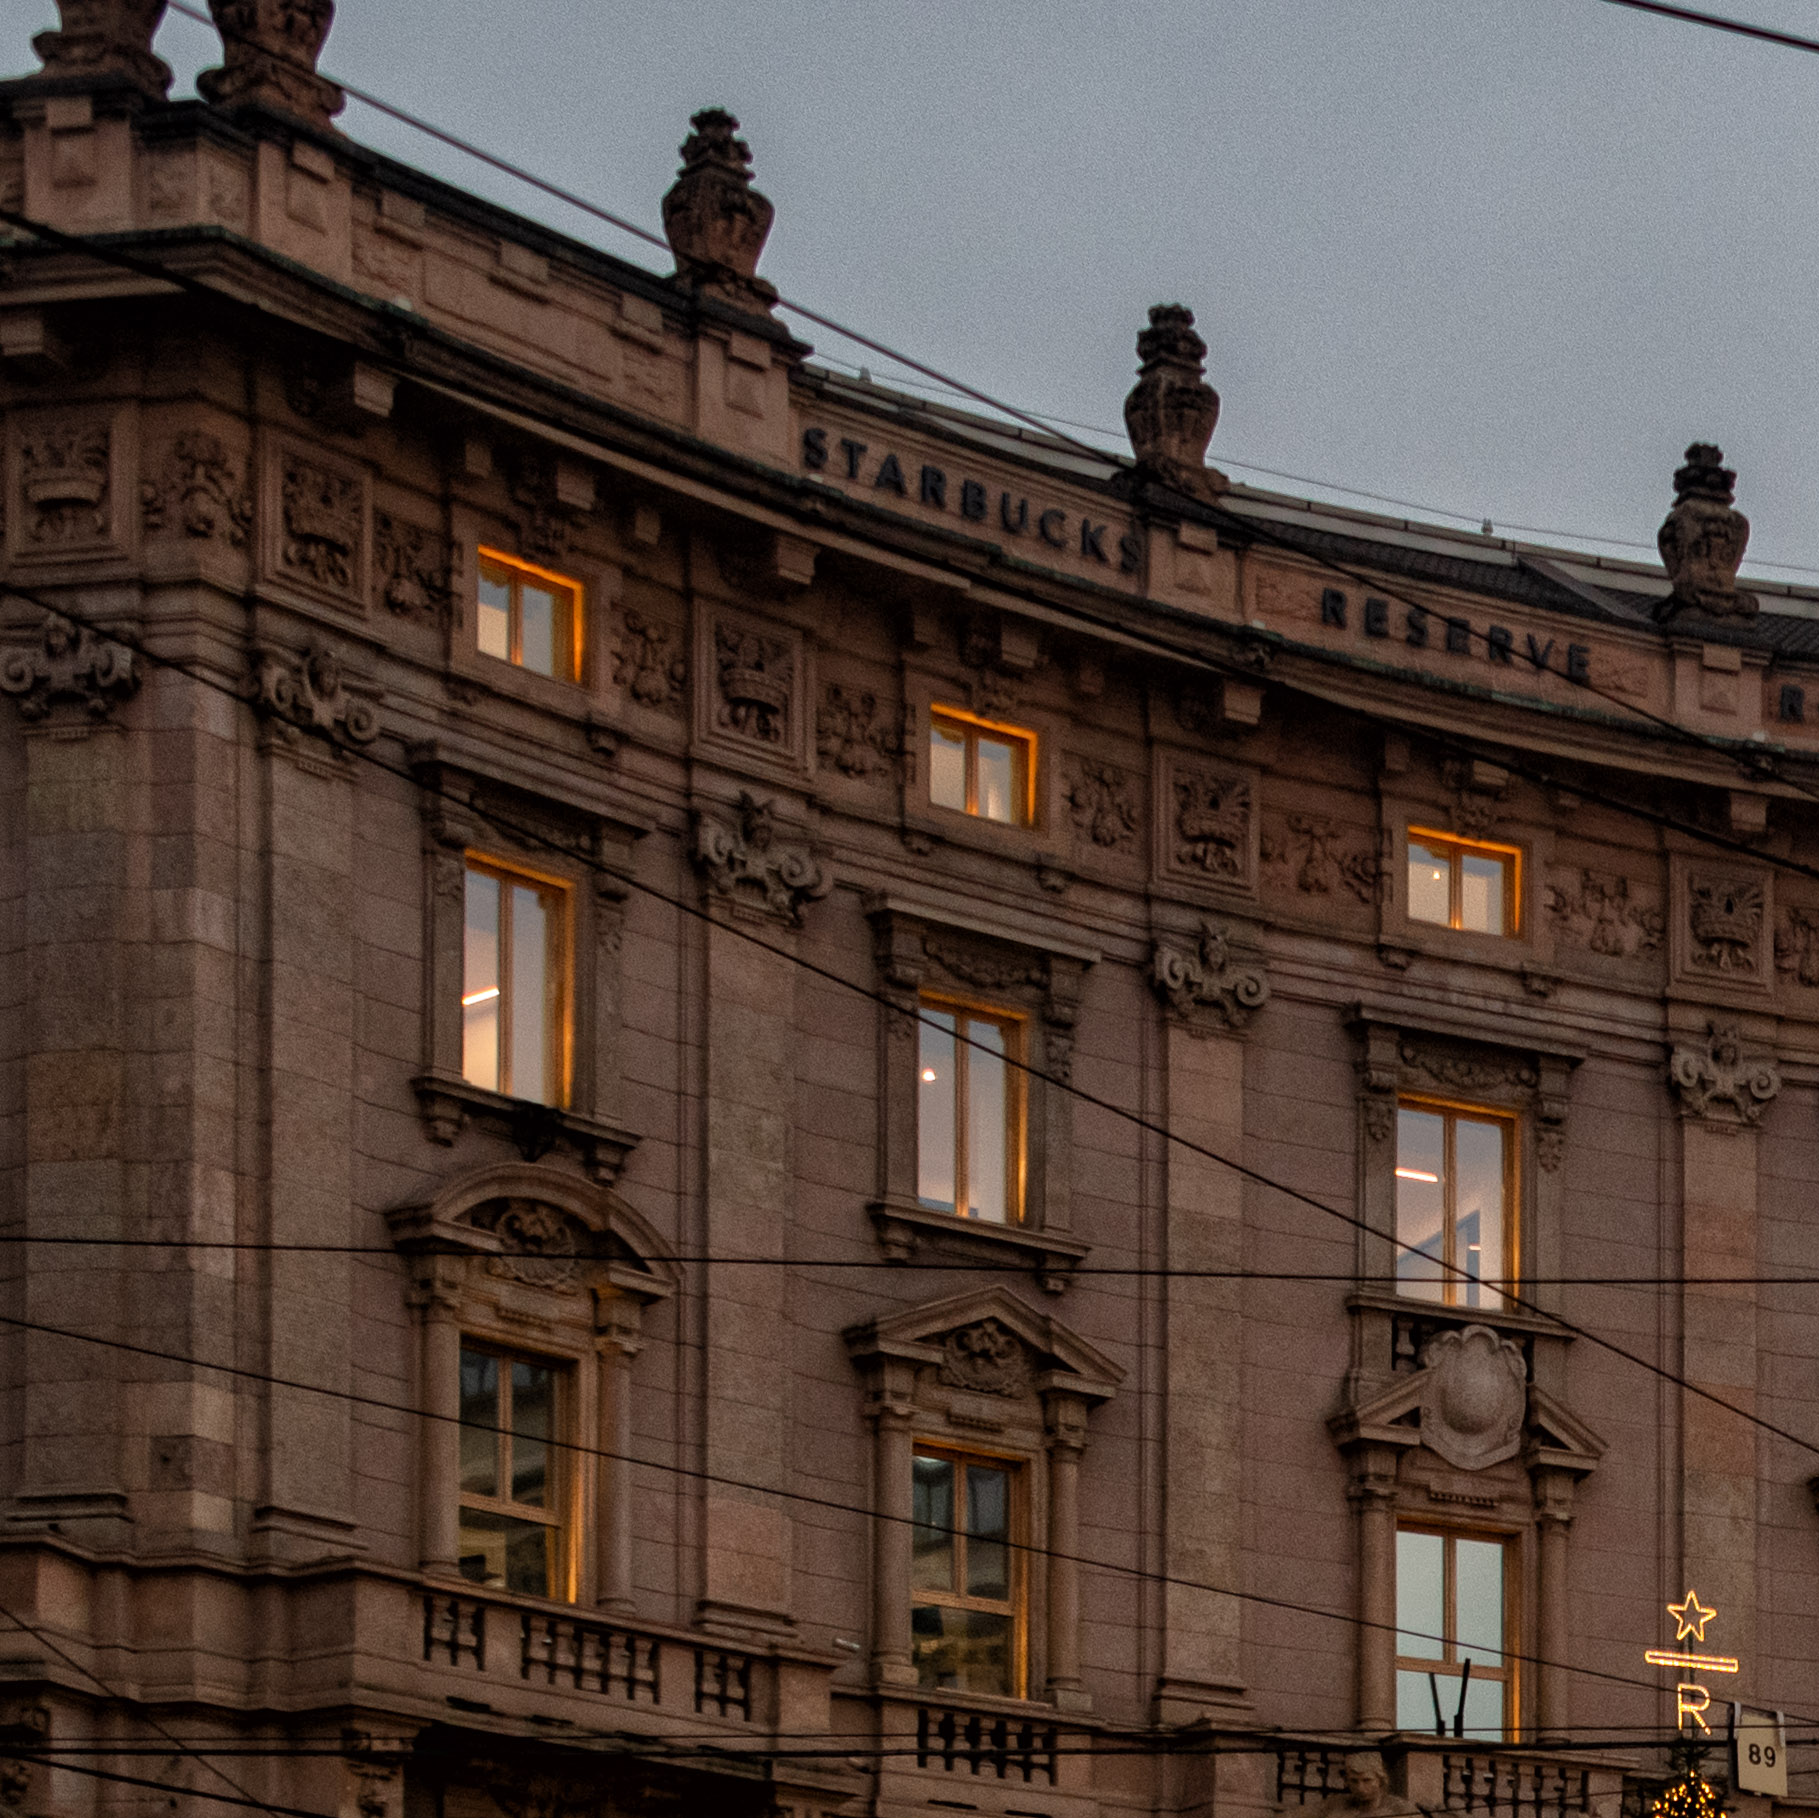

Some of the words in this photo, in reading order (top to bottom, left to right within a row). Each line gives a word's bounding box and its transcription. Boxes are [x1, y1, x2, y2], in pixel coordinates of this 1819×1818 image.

[802, 427, 1141, 576] STARBUCKS
[1321, 587, 1593, 687] RESERVE
[1677, 1682, 1711, 1735] R
[1747, 1743, 1776, 1768] 89
